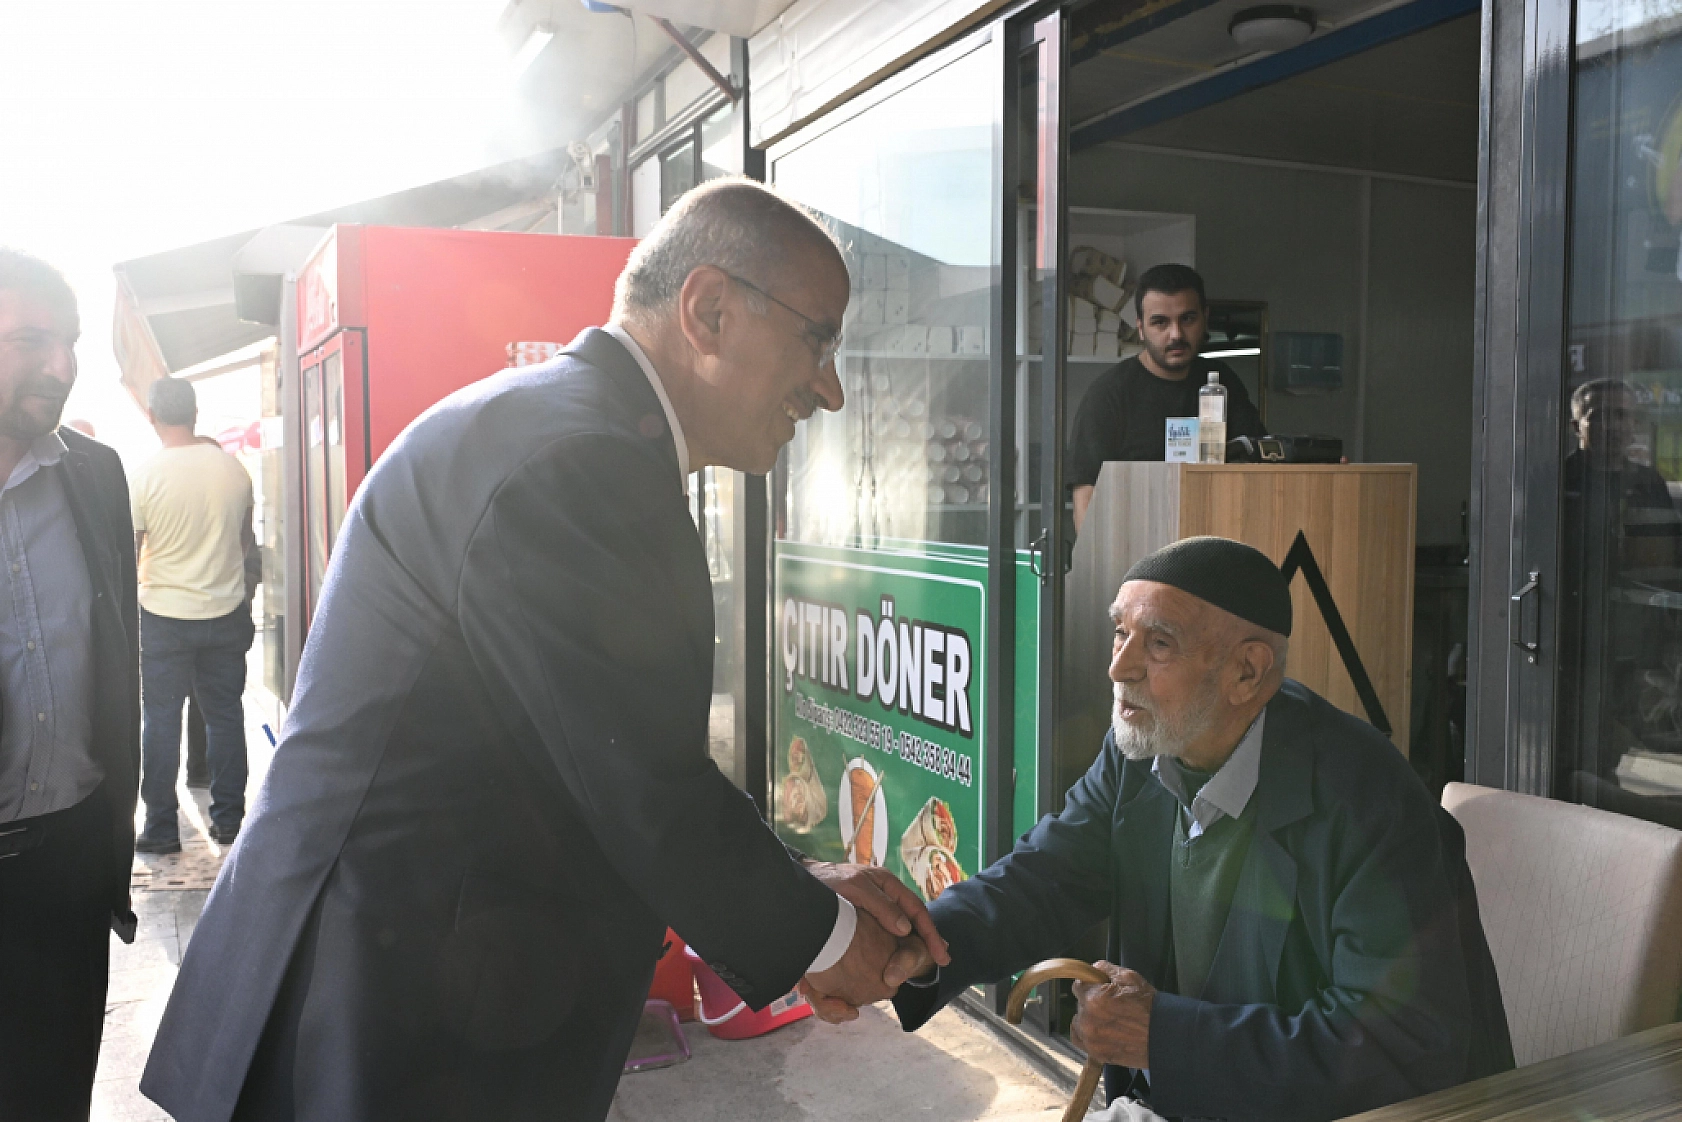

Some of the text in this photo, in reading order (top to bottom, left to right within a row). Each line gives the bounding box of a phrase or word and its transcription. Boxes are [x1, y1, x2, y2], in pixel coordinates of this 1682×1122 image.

[783, 597, 971, 735] ÇITIR DÖNER
[834, 706, 853, 738] 0422
[881, 724, 893, 754] 19
[899, 730, 922, 767] 0542
[942, 746, 957, 781] 34
[957, 753, 972, 788] 44
